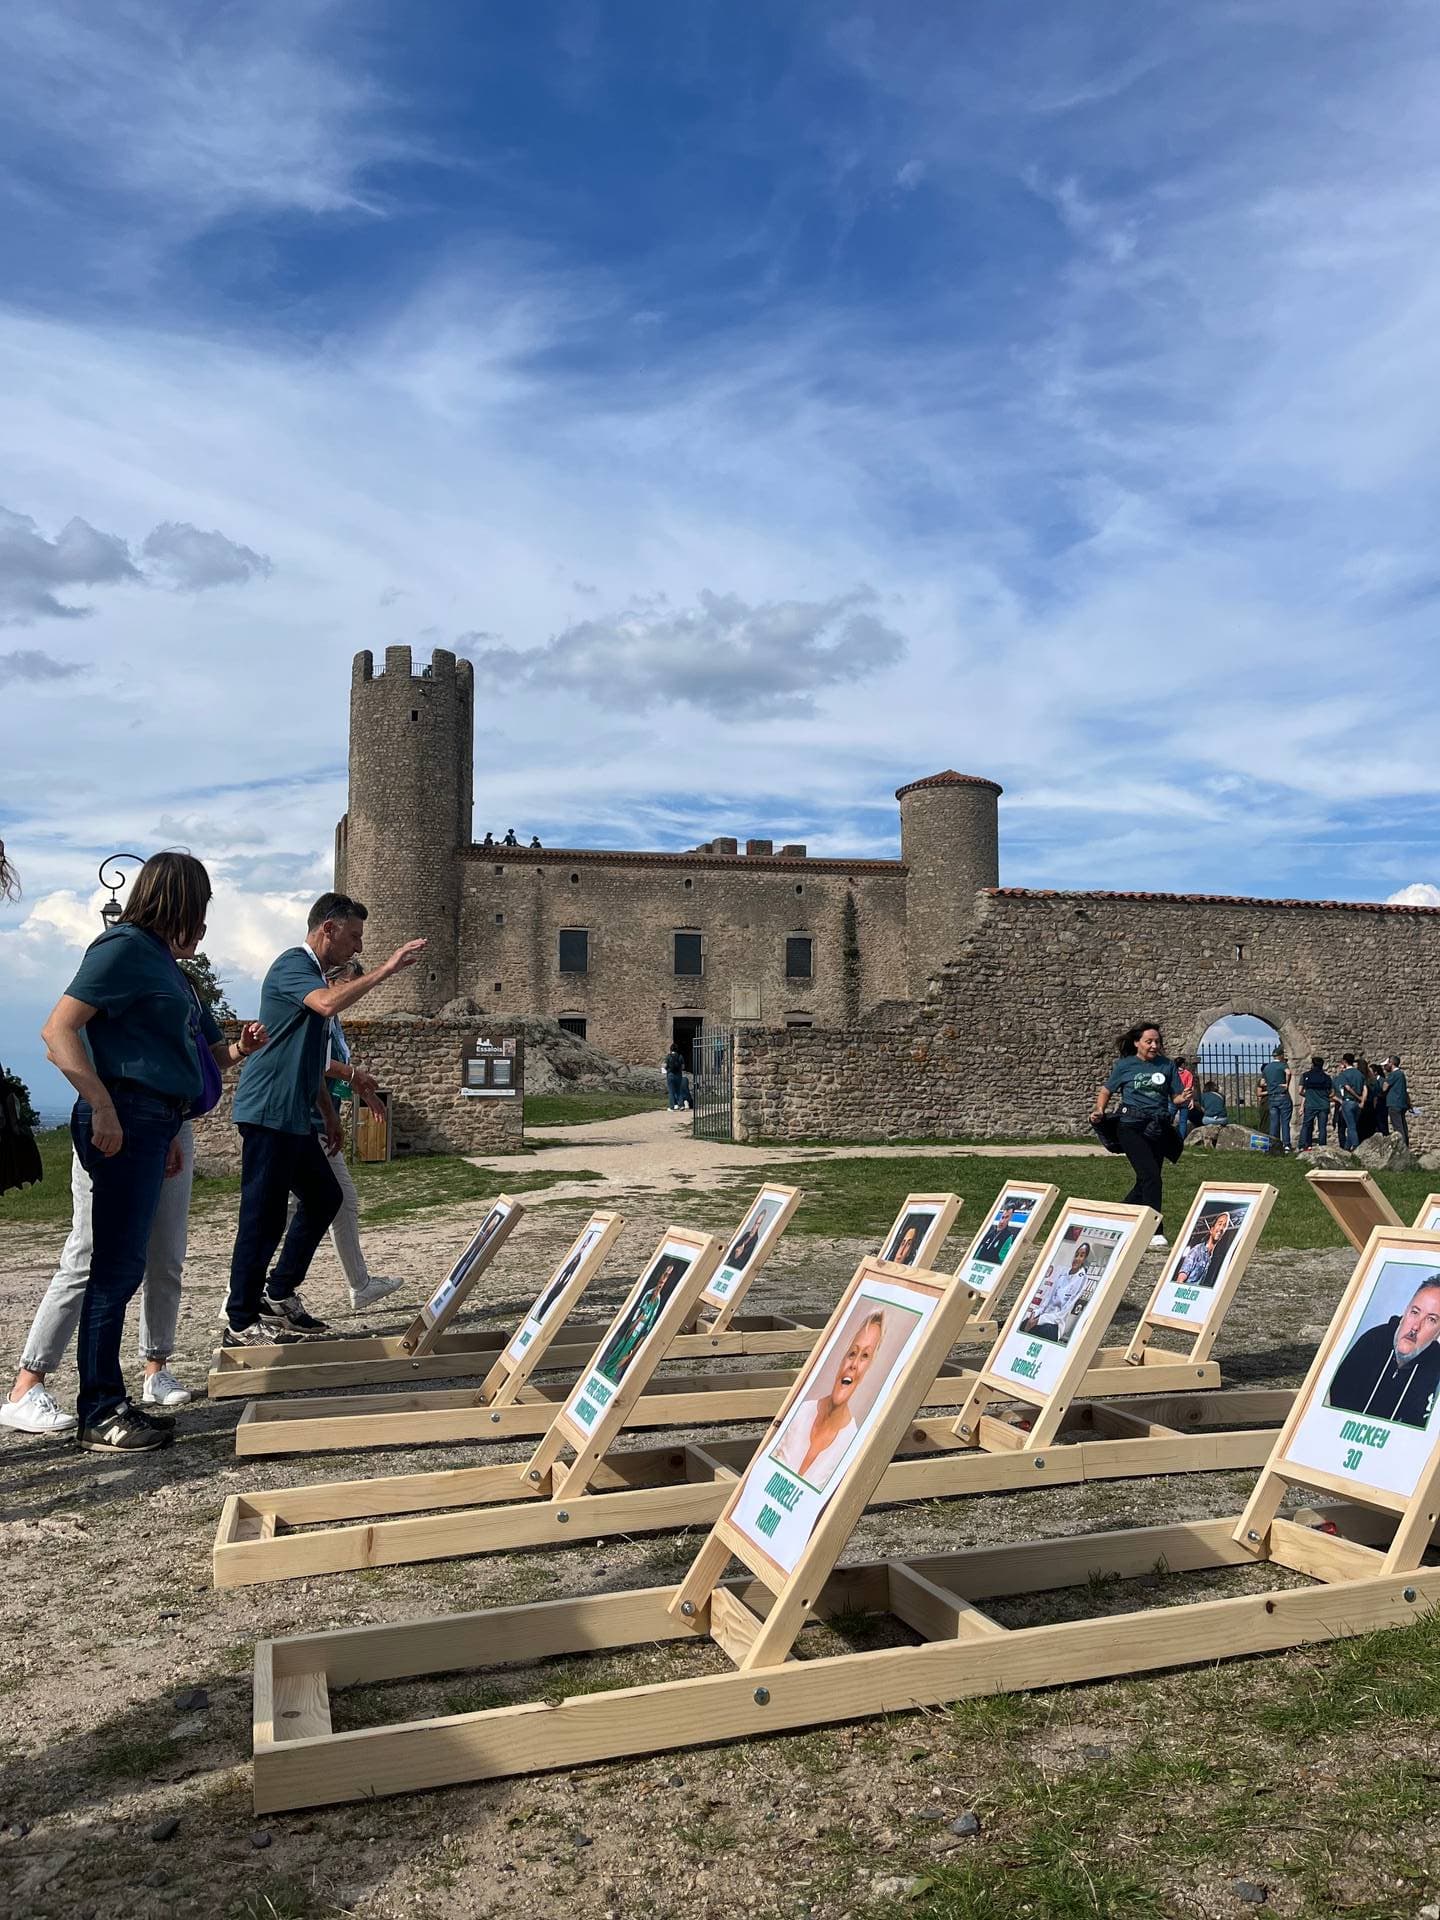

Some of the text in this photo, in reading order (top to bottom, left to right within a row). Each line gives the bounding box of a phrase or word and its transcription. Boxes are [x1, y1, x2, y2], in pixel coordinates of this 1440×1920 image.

[476, 1045, 503, 1053] Essalois
[1339, 1420, 1391, 1449] MICKEY
[755, 1503, 782, 1539] ROBIN
